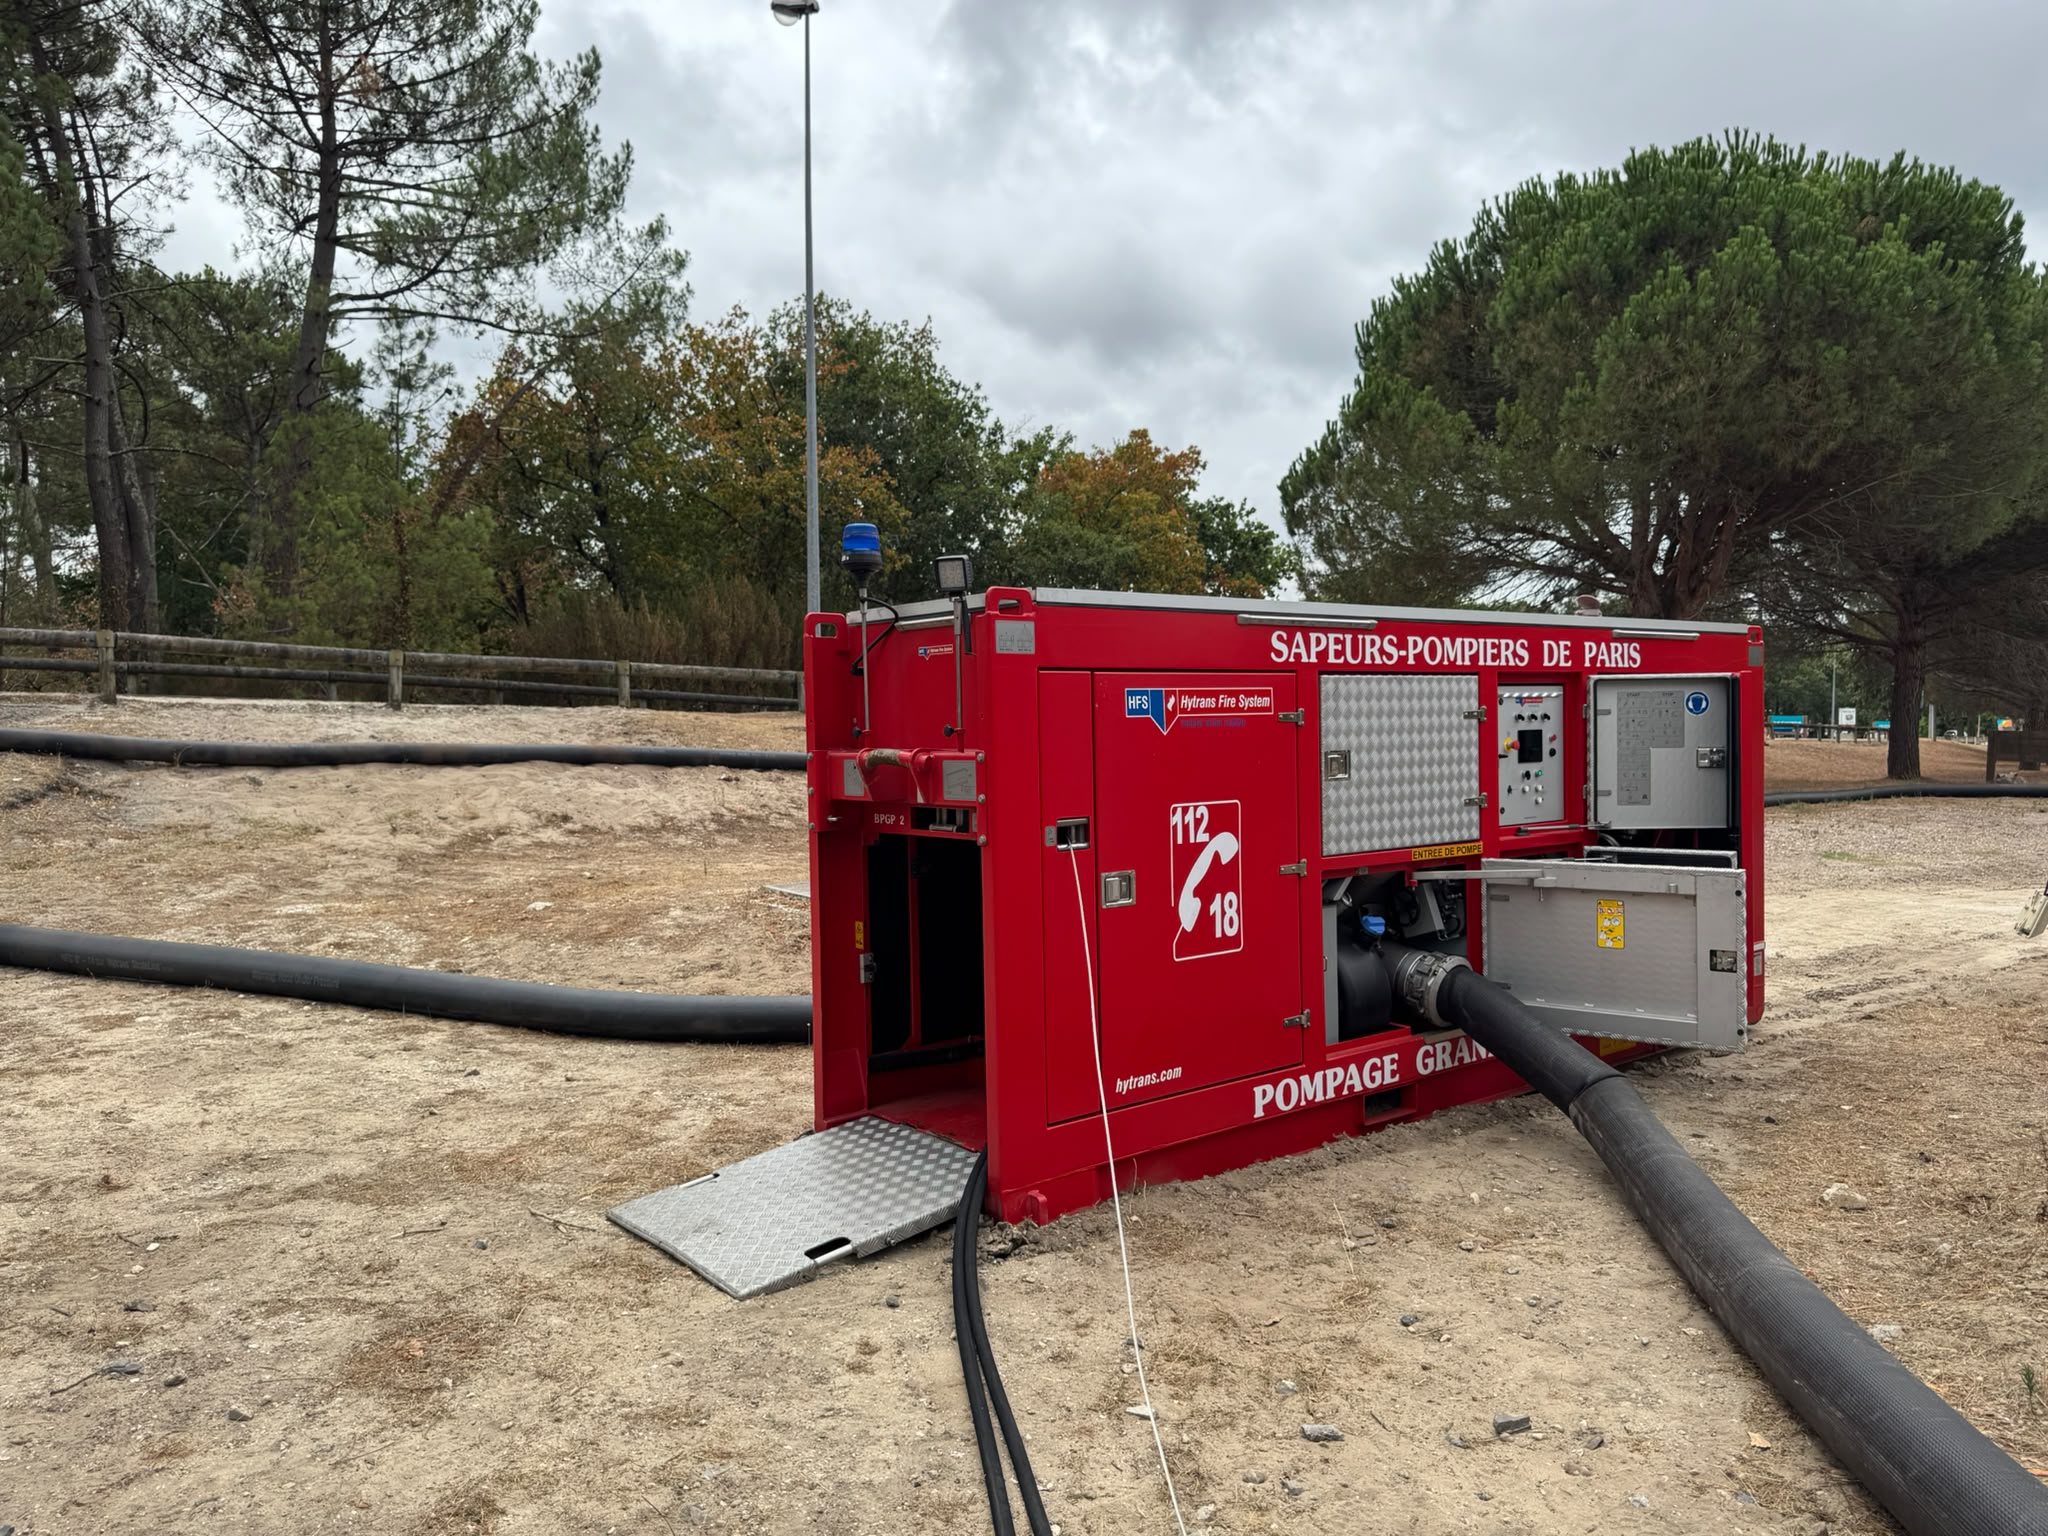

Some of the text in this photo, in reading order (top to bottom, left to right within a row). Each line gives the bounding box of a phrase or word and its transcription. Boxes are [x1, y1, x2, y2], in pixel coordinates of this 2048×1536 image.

[1271, 630, 1642, 669] SAPEURS-POMPIERS DE PARIS
[1128, 695, 1148, 709] HFS
[1180, 694, 1270, 711] Hytrans Fire System
[874, 813, 905, 825] BPGP 2
[1172, 805, 1210, 845] 112
[1412, 844, 1482, 860] ENTREE DE POMPE
[1210, 891, 1240, 938] 18
[1115, 1066, 1182, 1096] hytrans.com
[1253, 1036, 1495, 1119] POMPAGE GRAN
